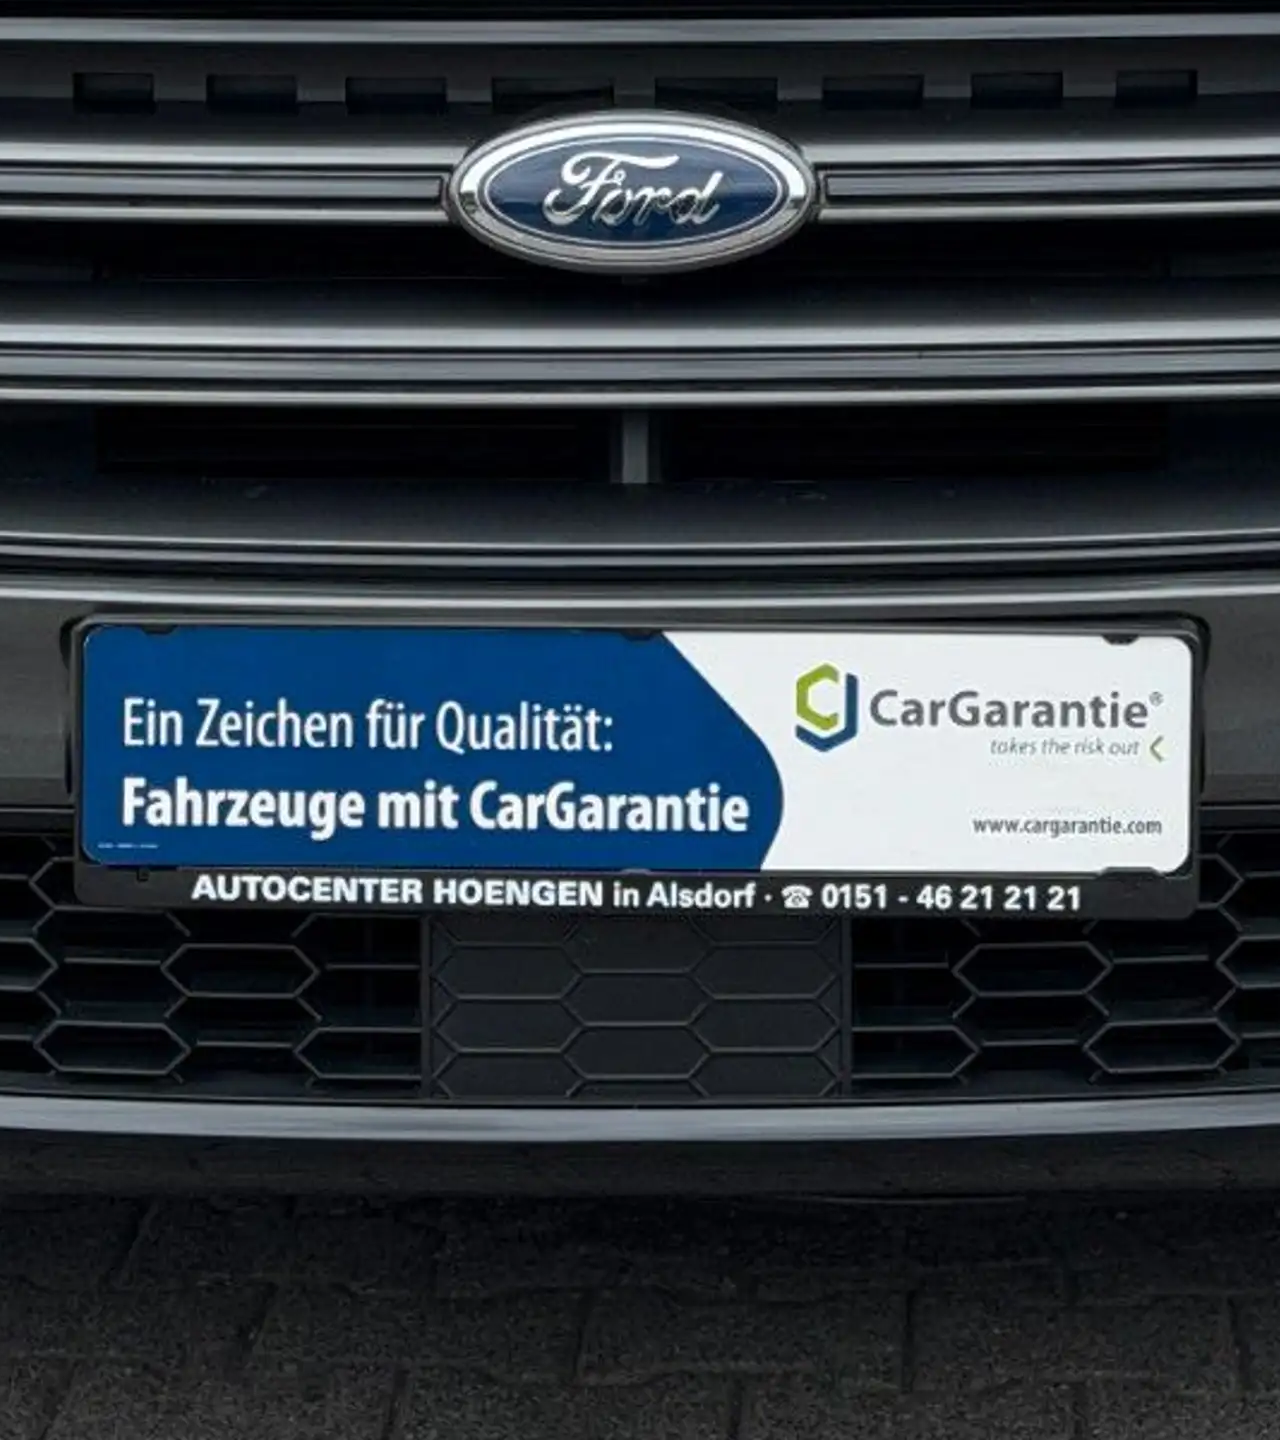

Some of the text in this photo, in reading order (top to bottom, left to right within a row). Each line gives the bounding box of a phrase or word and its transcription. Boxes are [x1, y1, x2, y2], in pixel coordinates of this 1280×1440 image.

[541, 149, 723, 226] Ford
[123, 697, 613, 755] Ein Zeichen für Qualität:
[989, 735, 1141, 757] takes the risk out
[122, 775, 750, 842] Fahrzeuge mit CarGarantie
[973, 816, 1163, 839] www.cargarantie.com
[191, 873, 423, 904] AUTOCENTER
[433, 877, 603, 908] HOENGEN
[613, 881, 640, 908] in
[646, 882, 757, 910] Alsdorf
[821, 884, 888, 911] 0151
[916, 885, 953, 911] 46
[960, 885, 993, 912] 21
[1003, 886, 1036, 912] 21
[1046, 886, 1081, 912] 21
